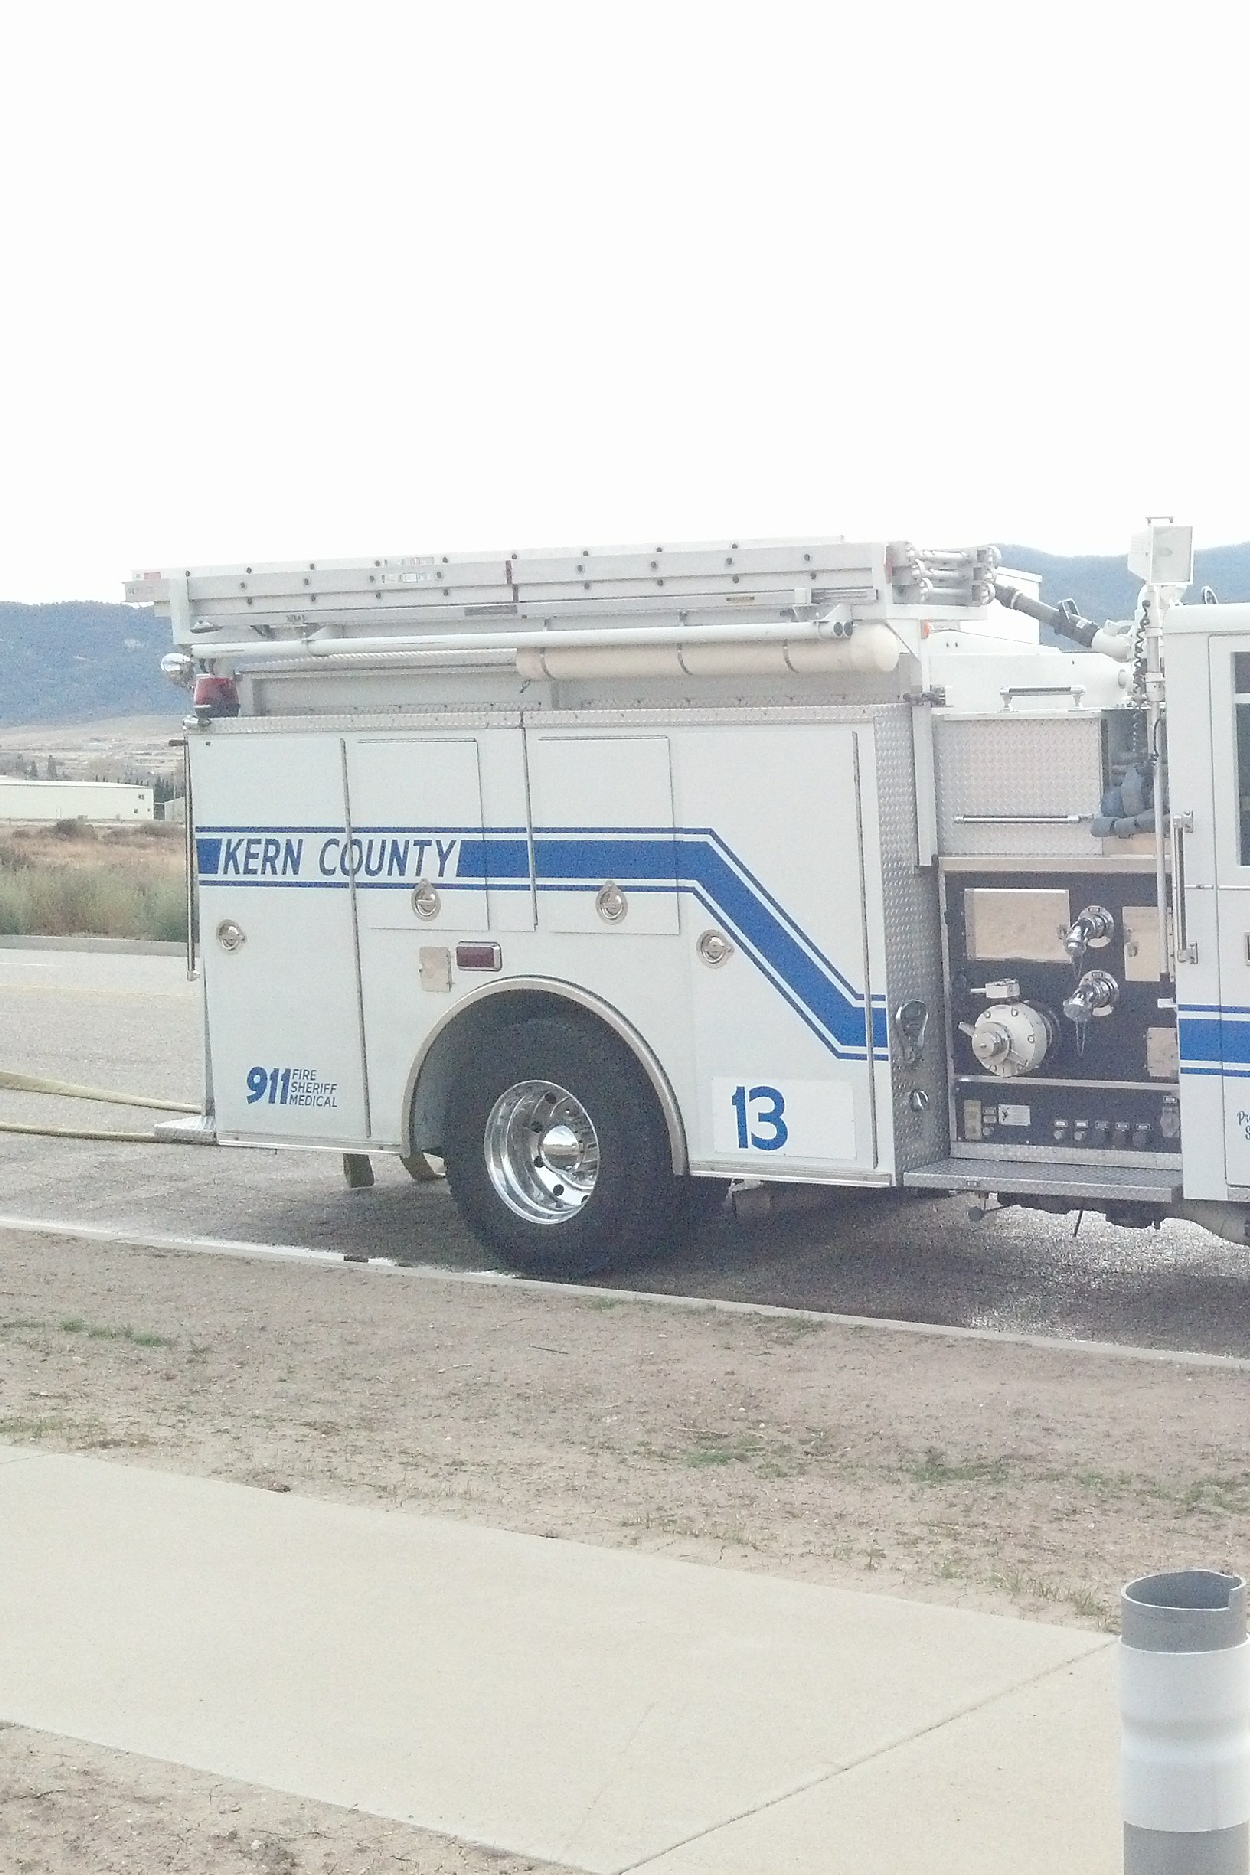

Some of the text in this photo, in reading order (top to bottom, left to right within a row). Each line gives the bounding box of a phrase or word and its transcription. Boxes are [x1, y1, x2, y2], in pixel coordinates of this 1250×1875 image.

[223, 838, 456, 877] KERN COUNTY
[246, 1066, 291, 1104] 911
[291, 1068, 317, 1081] FIRE
[288, 1094, 338, 1108] MEDICAL
[290, 1081, 338, 1095] SHERIFF
[731, 1085, 788, 1151] 13
